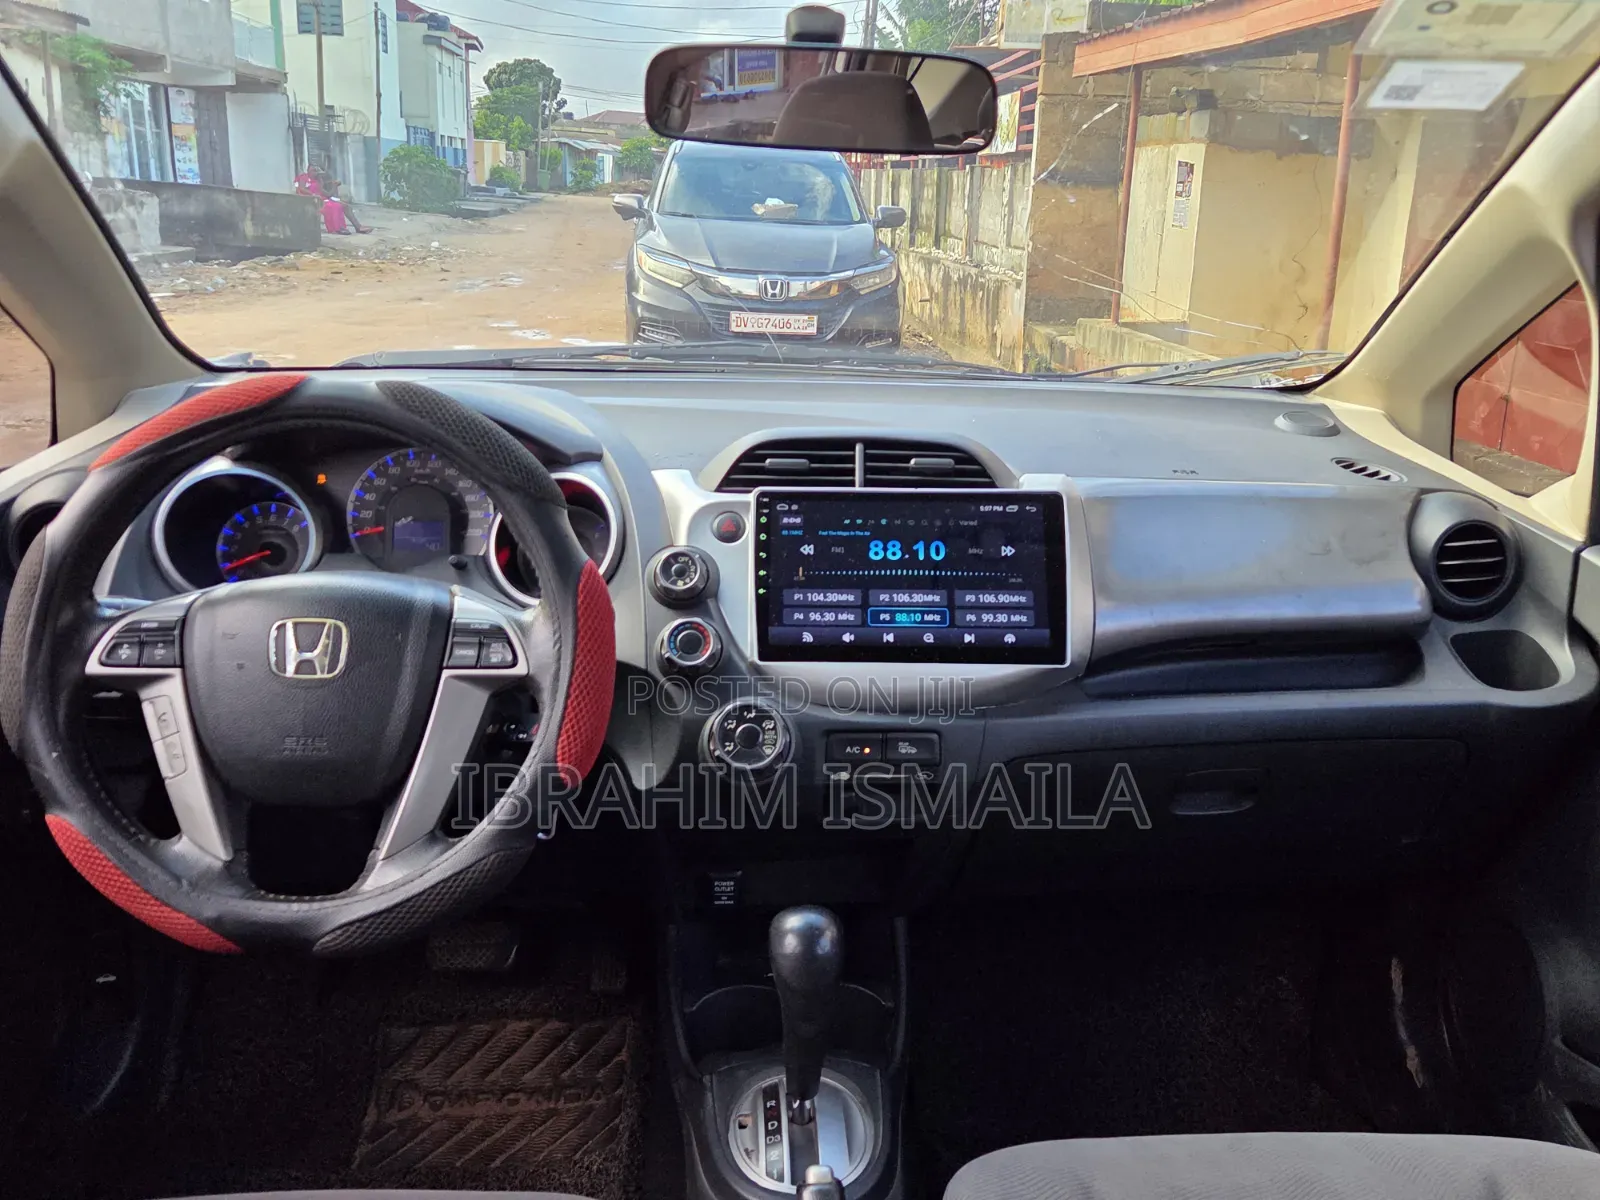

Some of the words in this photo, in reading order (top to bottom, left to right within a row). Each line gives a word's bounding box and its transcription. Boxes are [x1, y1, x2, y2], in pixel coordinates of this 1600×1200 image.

[735, 316, 749, 328] DV
[374, 476, 387, 486] 60
[363, 493, 377, 501] 40
[359, 508, 373, 518] 20
[868, 539, 946, 561] 88.10
[794, 593, 804, 601] P1
[880, 594, 890, 602] P2
[794, 612, 804, 621] P4
[809, 612, 836, 621] 96.30
[838, 612, 855, 621] MHz
[880, 613, 891, 621] P5
[895, 612, 922, 622] 88.10
[924, 613, 941, 621] MHz
[966, 614, 976, 622] P6
[981, 613, 1008, 622] 99.30
[1010, 614, 1028, 622] MHz
[846, 746, 860, 754] A/C
[766, 1100, 776, 1108] R
[768, 1121, 778, 1130] D
[766, 1134, 780, 1145] D3
[770, 1150, 779, 1161] 2
[772, 1168, 778, 1180] 1
